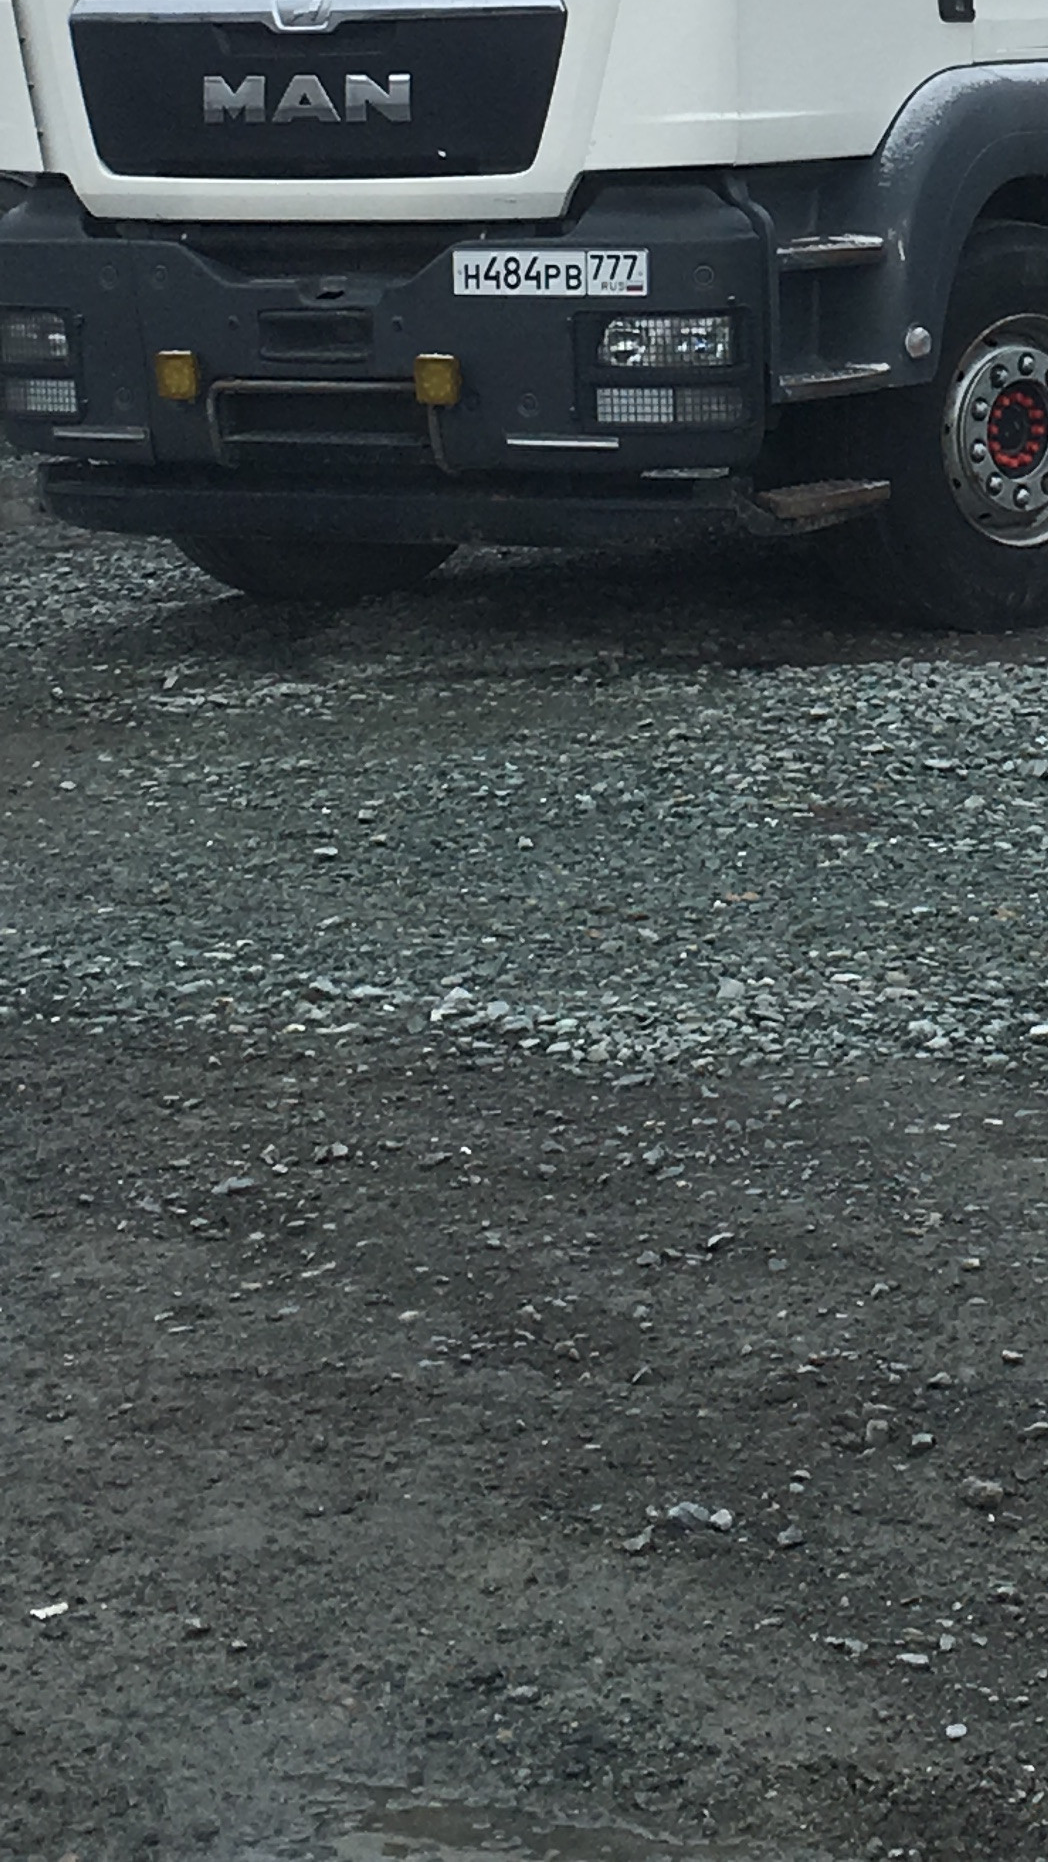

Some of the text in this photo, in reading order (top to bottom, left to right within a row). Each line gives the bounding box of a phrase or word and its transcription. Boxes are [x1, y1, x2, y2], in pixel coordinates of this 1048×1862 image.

[203, 74, 411, 123] MAN
[589, 254, 639, 281] 777
[601, 280, 626, 291] RUS
